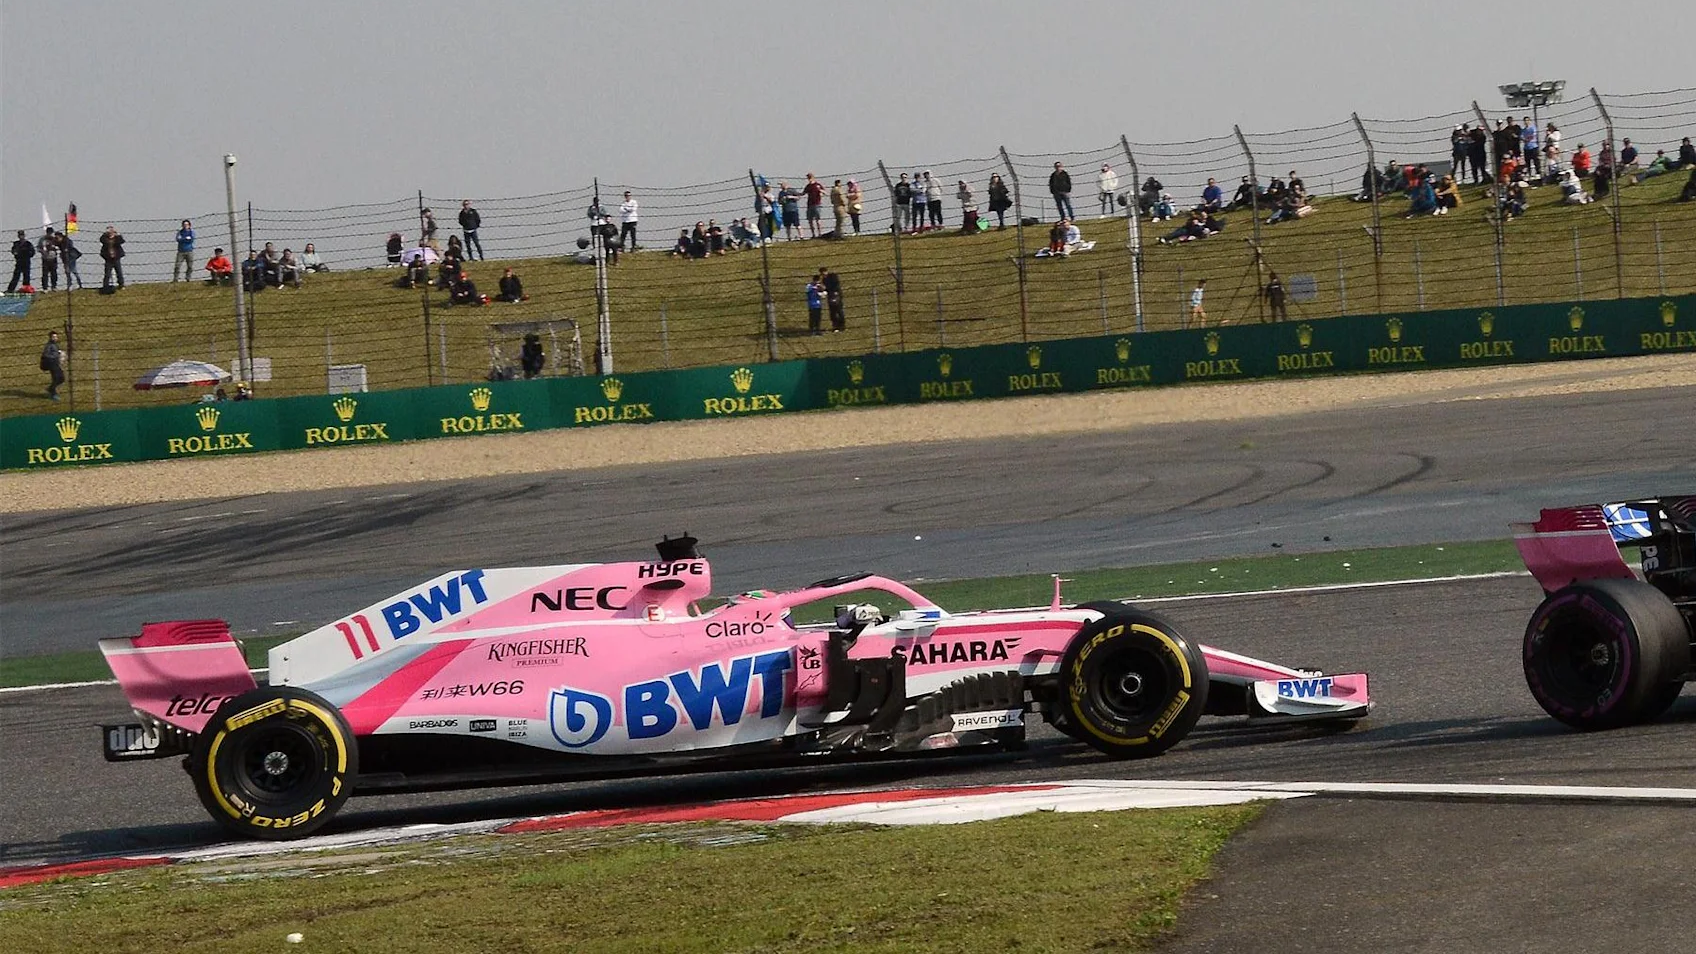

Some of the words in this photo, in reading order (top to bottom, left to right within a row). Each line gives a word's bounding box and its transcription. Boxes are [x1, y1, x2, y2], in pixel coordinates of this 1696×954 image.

[1368, 345, 1425, 364] ROLEX
[1460, 340, 1514, 359] ROLEX
[1549, 335, 1605, 354] ROLEX
[1186, 358, 1240, 377] ROLEX
[1278, 351, 1333, 370] ROLEX
[1009, 372, 1061, 391] ROLEX
[1097, 365, 1151, 384] ROLEX
[827, 386, 885, 405] ROLEX
[920, 380, 973, 398] ROLEX
[575, 403, 654, 423] ROLEX
[704, 394, 784, 414] ROLEX
[441, 413, 523, 433] ROLEX
[168, 433, 254, 454] ROLEX
[306, 423, 389, 444] ROLEX
[28, 443, 113, 464] ROLEX
[1641, 546, 1659, 572] PE
[638, 563, 703, 578] HYPE
[530, 586, 628, 613] NEC
[335, 614, 381, 660] 11
[380, 568, 489, 640] BWT
[648, 609, 659, 622] E
[706, 615, 769, 638] Claro
[488, 637, 589, 661] KINGFISHER
[891, 640, 1009, 665] SAHARA
[516, 658, 558, 666] PREMIUM
[625, 650, 792, 739] BWT
[1278, 679, 1331, 697] BWT
[165, 695, 235, 716] telc
[409, 719, 458, 729] BARBADOS
[251, 799, 326, 828] ZERO
